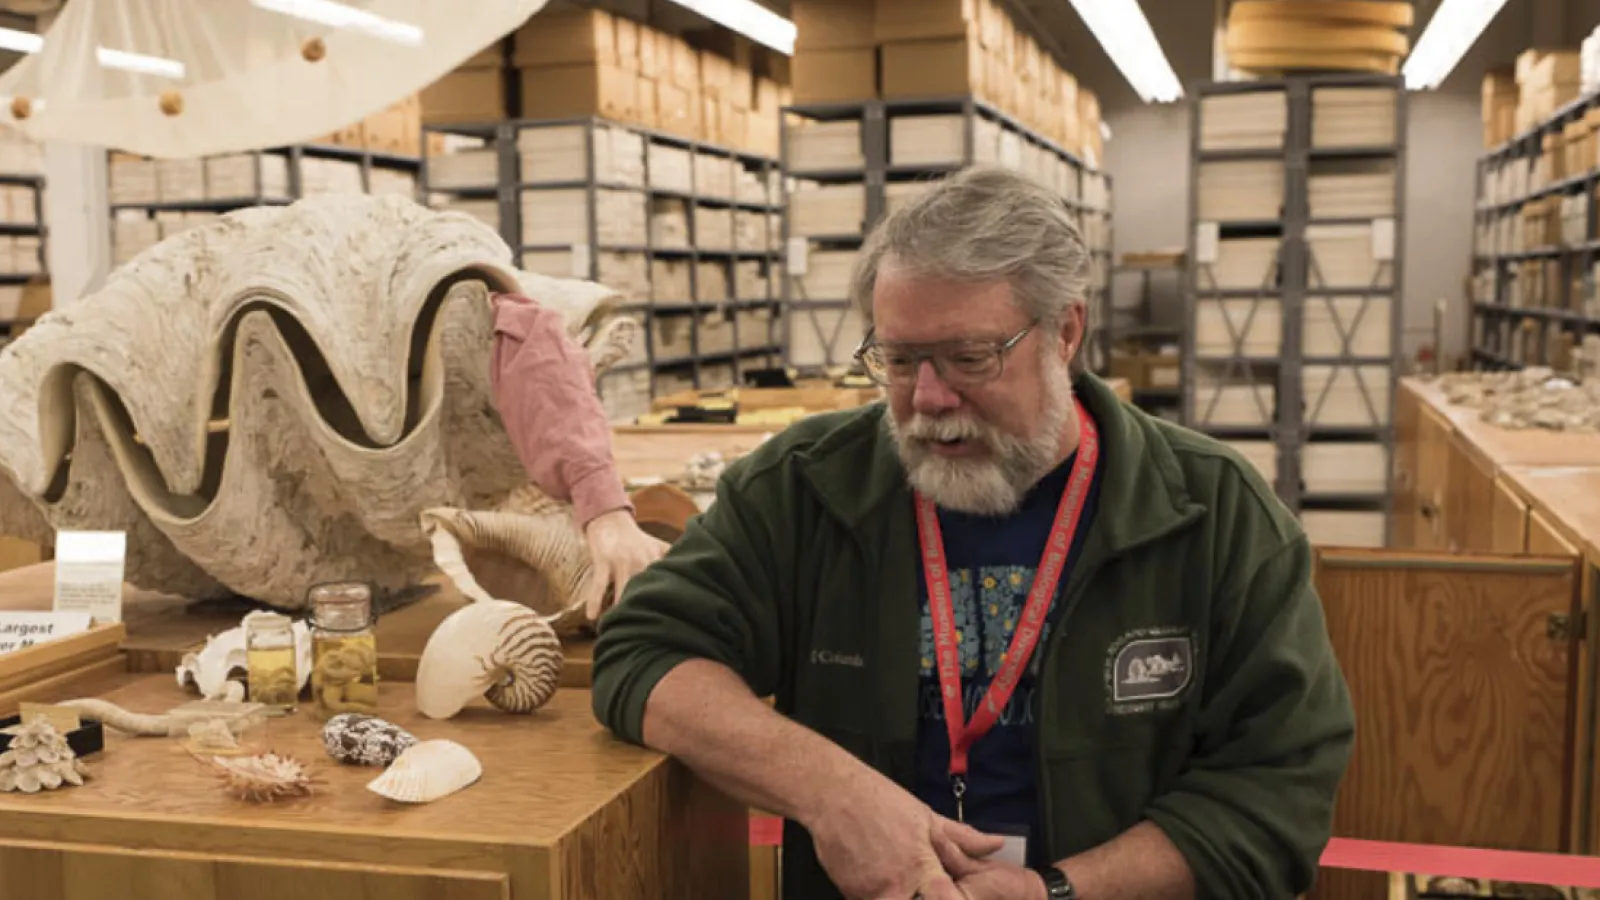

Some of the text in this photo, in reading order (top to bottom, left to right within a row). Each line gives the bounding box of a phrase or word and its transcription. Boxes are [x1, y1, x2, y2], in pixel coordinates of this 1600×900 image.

[1061, 466, 1090, 529] Museum
[1054, 530, 1067, 549] of
[928, 563, 941, 577] of
[1028, 550, 1062, 623] Biological
[933, 581, 951, 646] Museum
[941, 650, 955, 678] The
